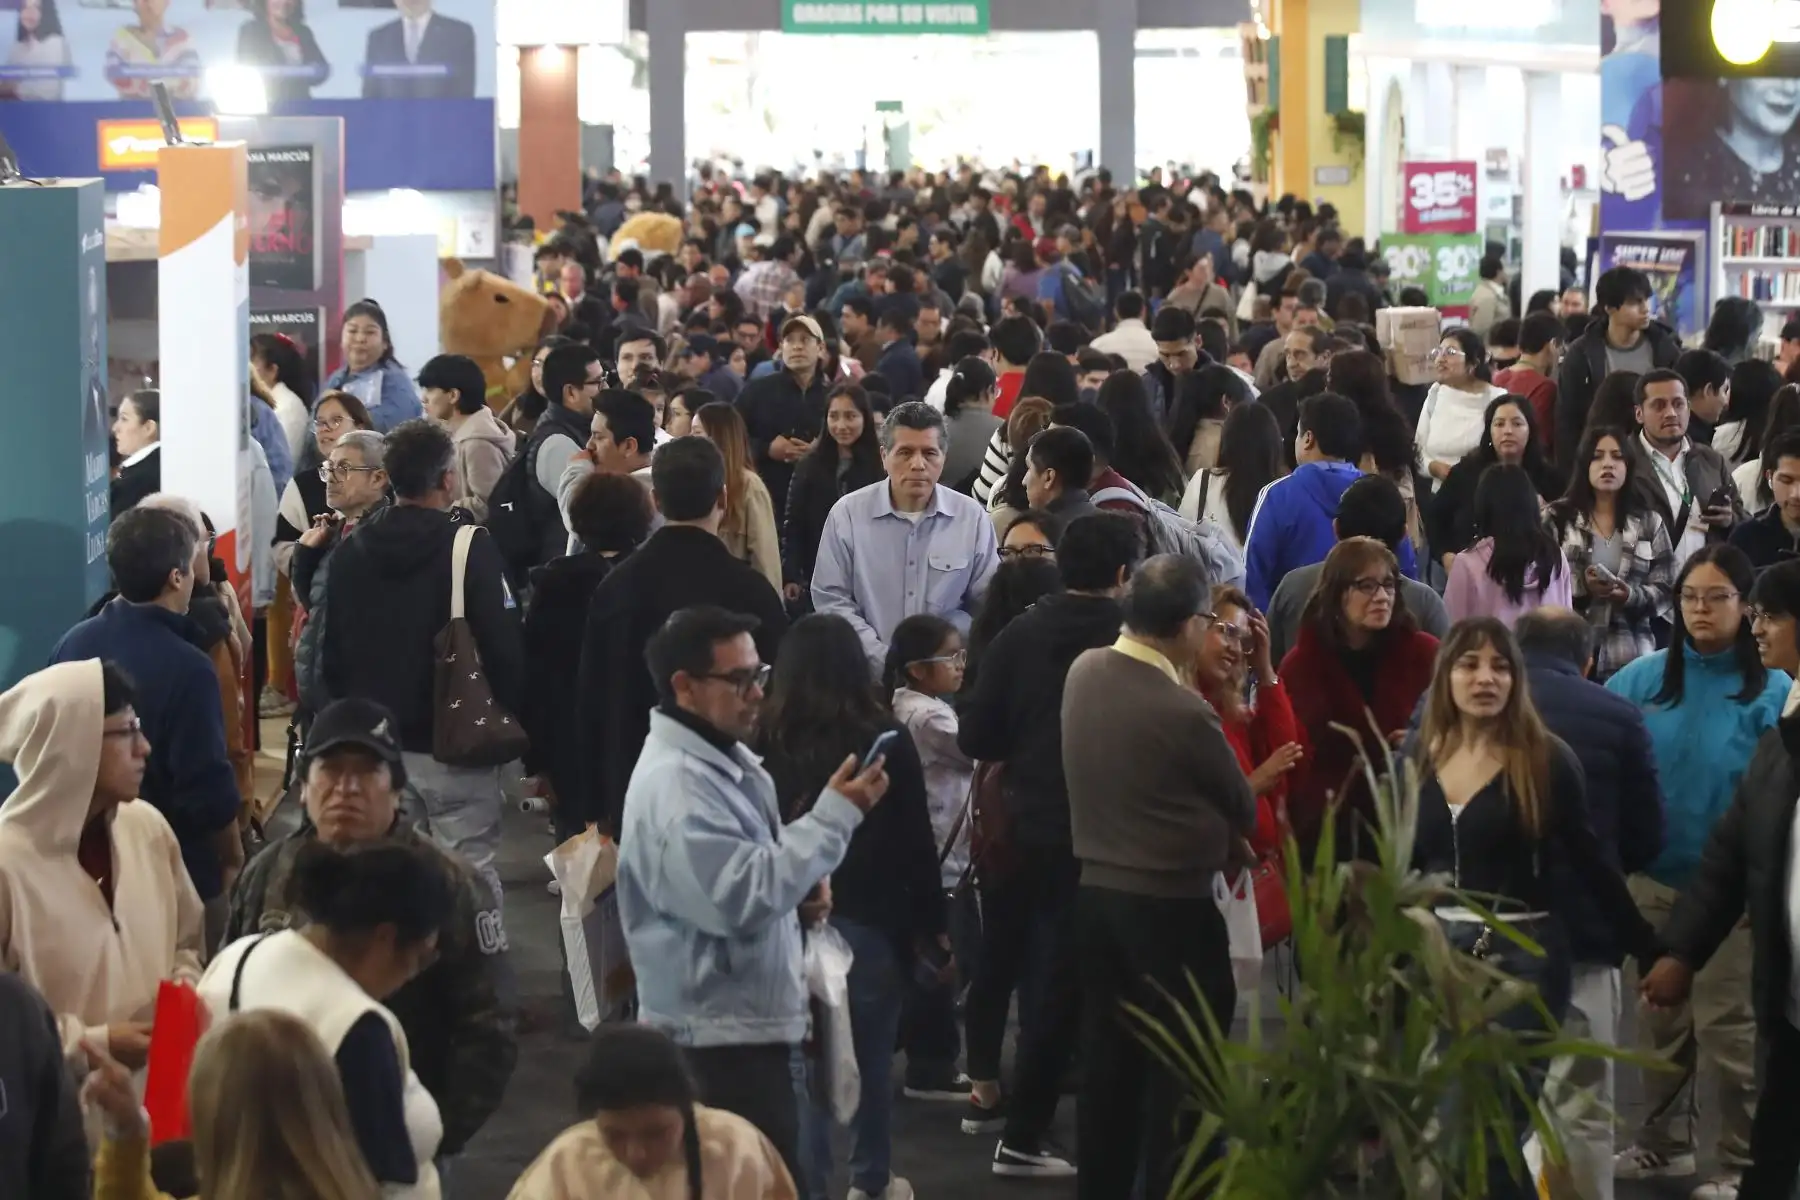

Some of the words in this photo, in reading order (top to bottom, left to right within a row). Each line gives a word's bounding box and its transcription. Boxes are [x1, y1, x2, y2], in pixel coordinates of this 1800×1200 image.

[793, 3, 863, 25] GRACIAS
[865, 4, 899, 25] POR
[901, 4, 923, 24] SU
[925, 4, 978, 24] VISITA
[271, 311, 316, 324] MARCÚS
